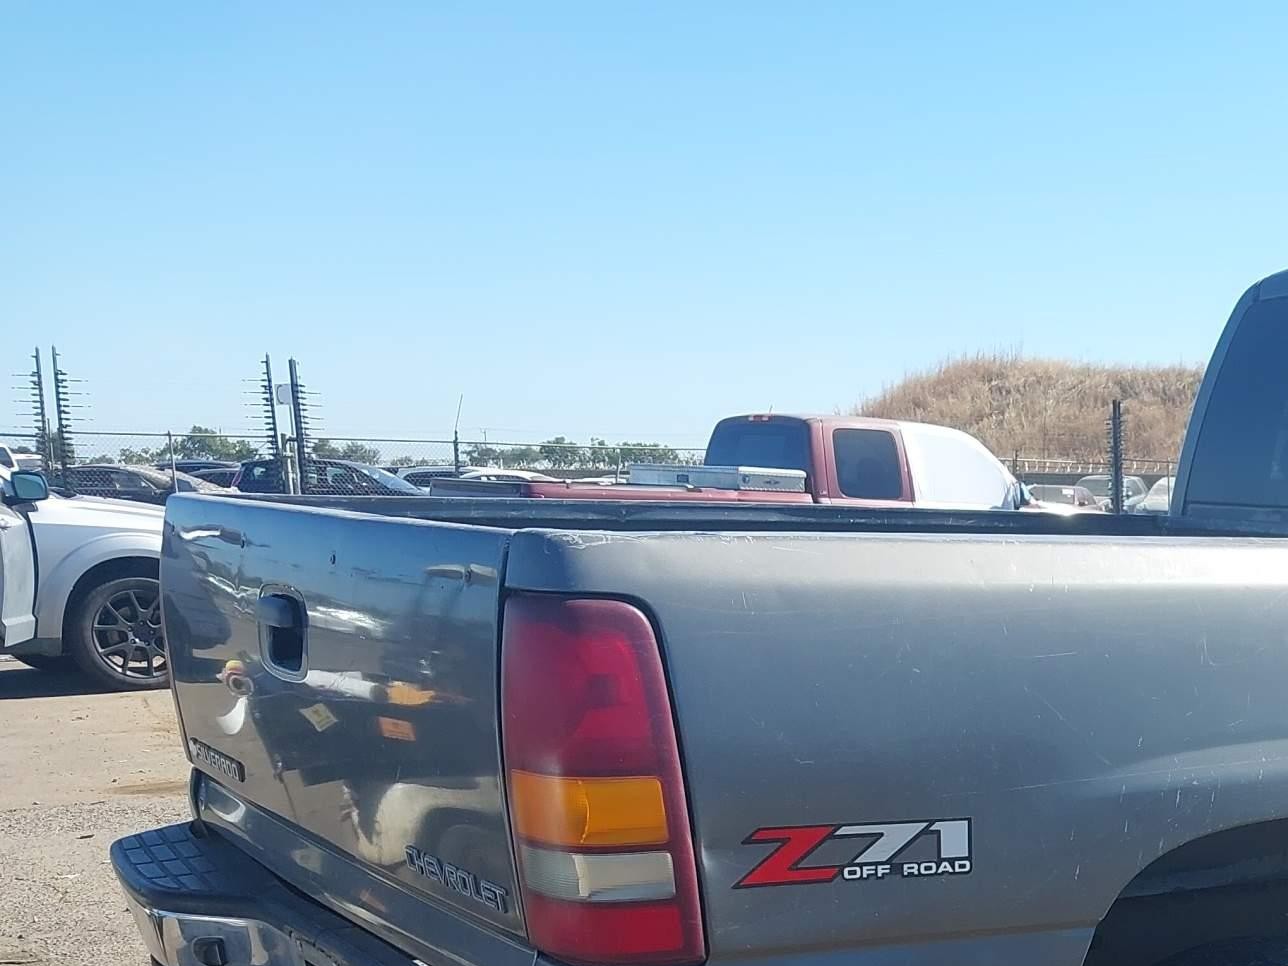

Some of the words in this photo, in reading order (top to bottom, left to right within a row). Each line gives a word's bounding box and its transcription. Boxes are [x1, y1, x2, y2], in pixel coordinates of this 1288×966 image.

[196, 743, 240, 781] SILVERADO
[404, 845, 507, 914] CHEVROLET
[731, 817, 972, 889] Z71
[842, 864, 891, 881] OFF
[902, 859, 972, 877] ROAD
